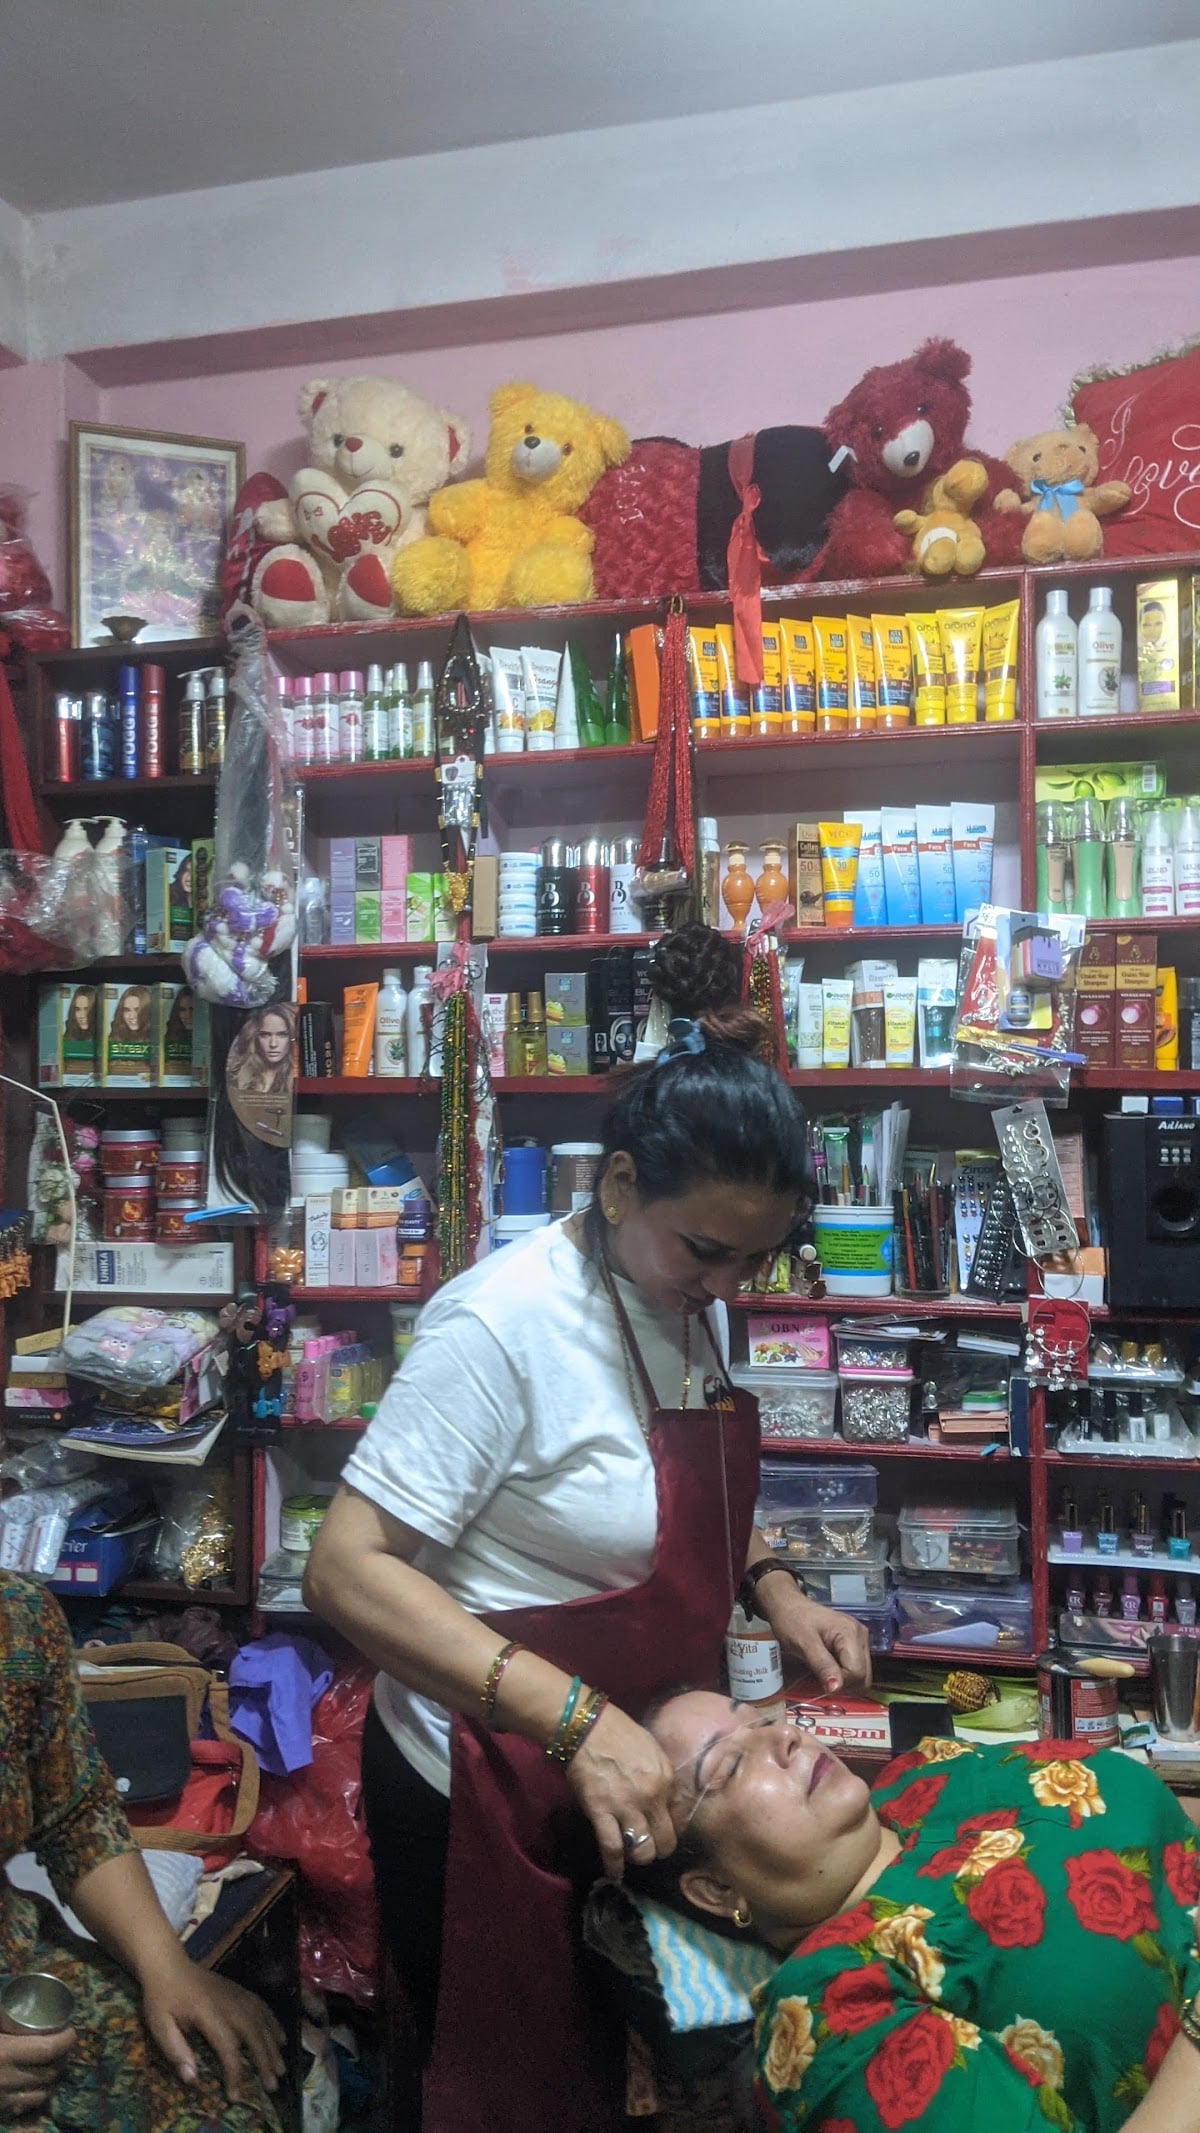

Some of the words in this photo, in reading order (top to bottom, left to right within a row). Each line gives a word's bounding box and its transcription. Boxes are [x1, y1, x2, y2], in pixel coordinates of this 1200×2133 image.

[917, 623, 939, 632] arom
[944, 620, 977, 630] aroma
[1092, 640, 1115, 650] Olive
[800, 861, 814, 872] 50
[869, 870, 880, 878] 50
[379, 1015, 401, 1024] Olive
[111, 1043, 150, 1054] streax
[99, 1251, 110, 1283] UNIKA
[771, 1323, 800, 1333] OBN
